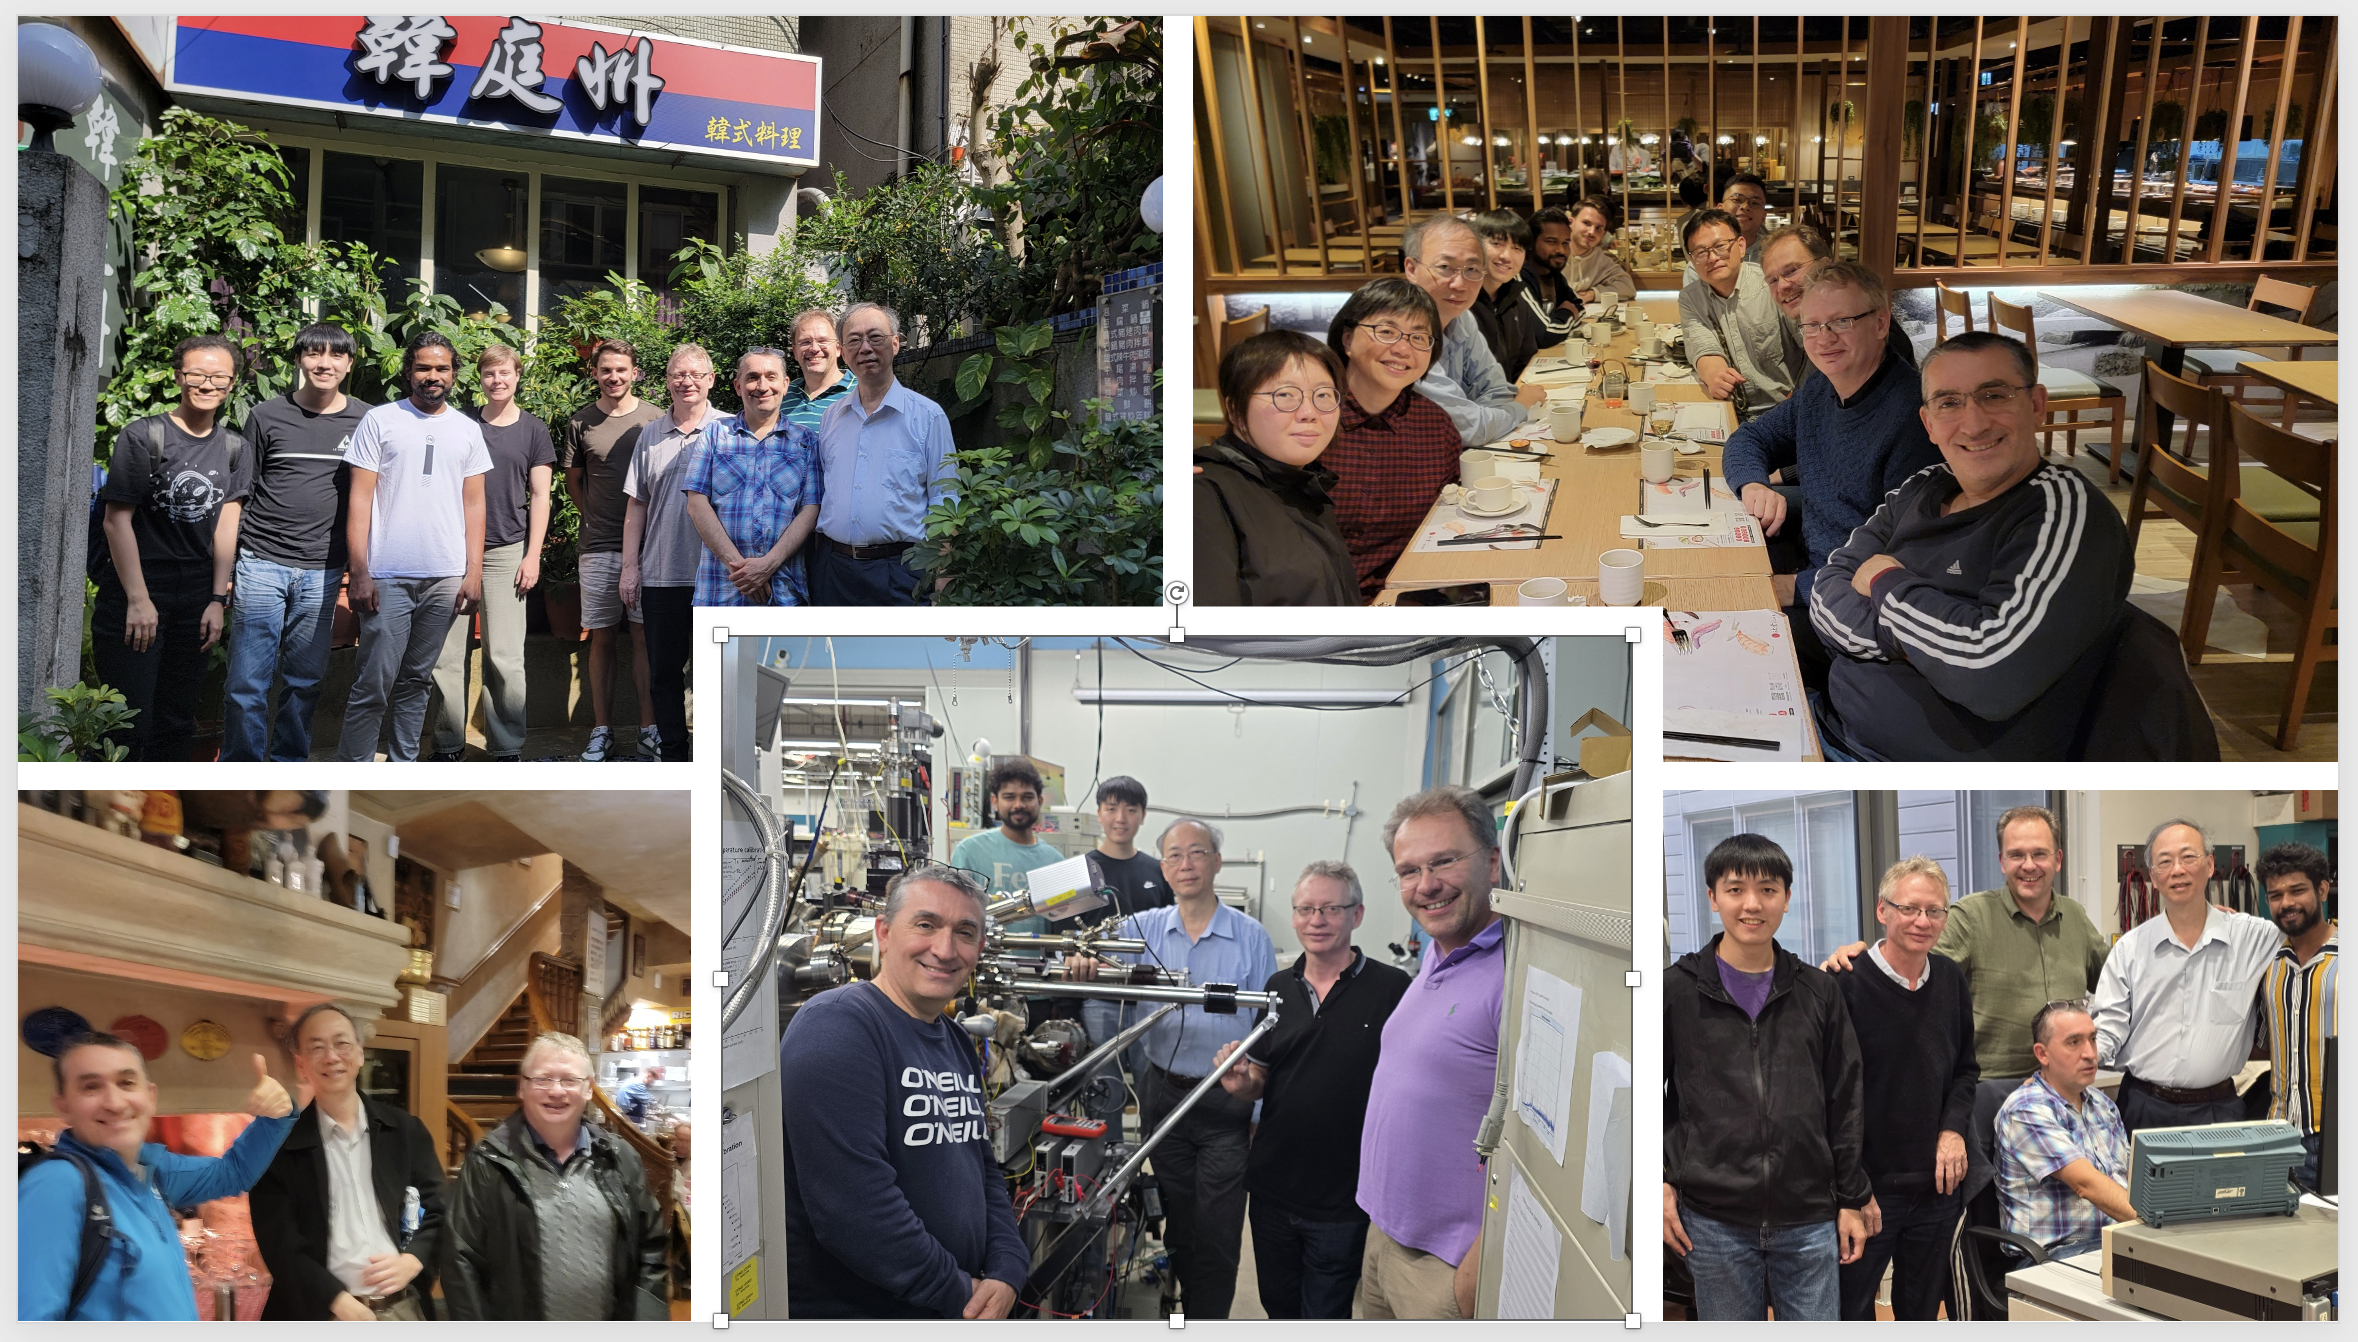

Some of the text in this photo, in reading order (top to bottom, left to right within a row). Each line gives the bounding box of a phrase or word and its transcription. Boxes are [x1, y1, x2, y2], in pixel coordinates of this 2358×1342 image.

[353, 16, 666, 126] 韓庭州
[704, 115, 803, 151] 韓式料理
[901, 1066, 982, 1094] O'NEILL
[903, 1094, 985, 1118] O'NEILL
[903, 1120, 990, 1147] O'NEILL
